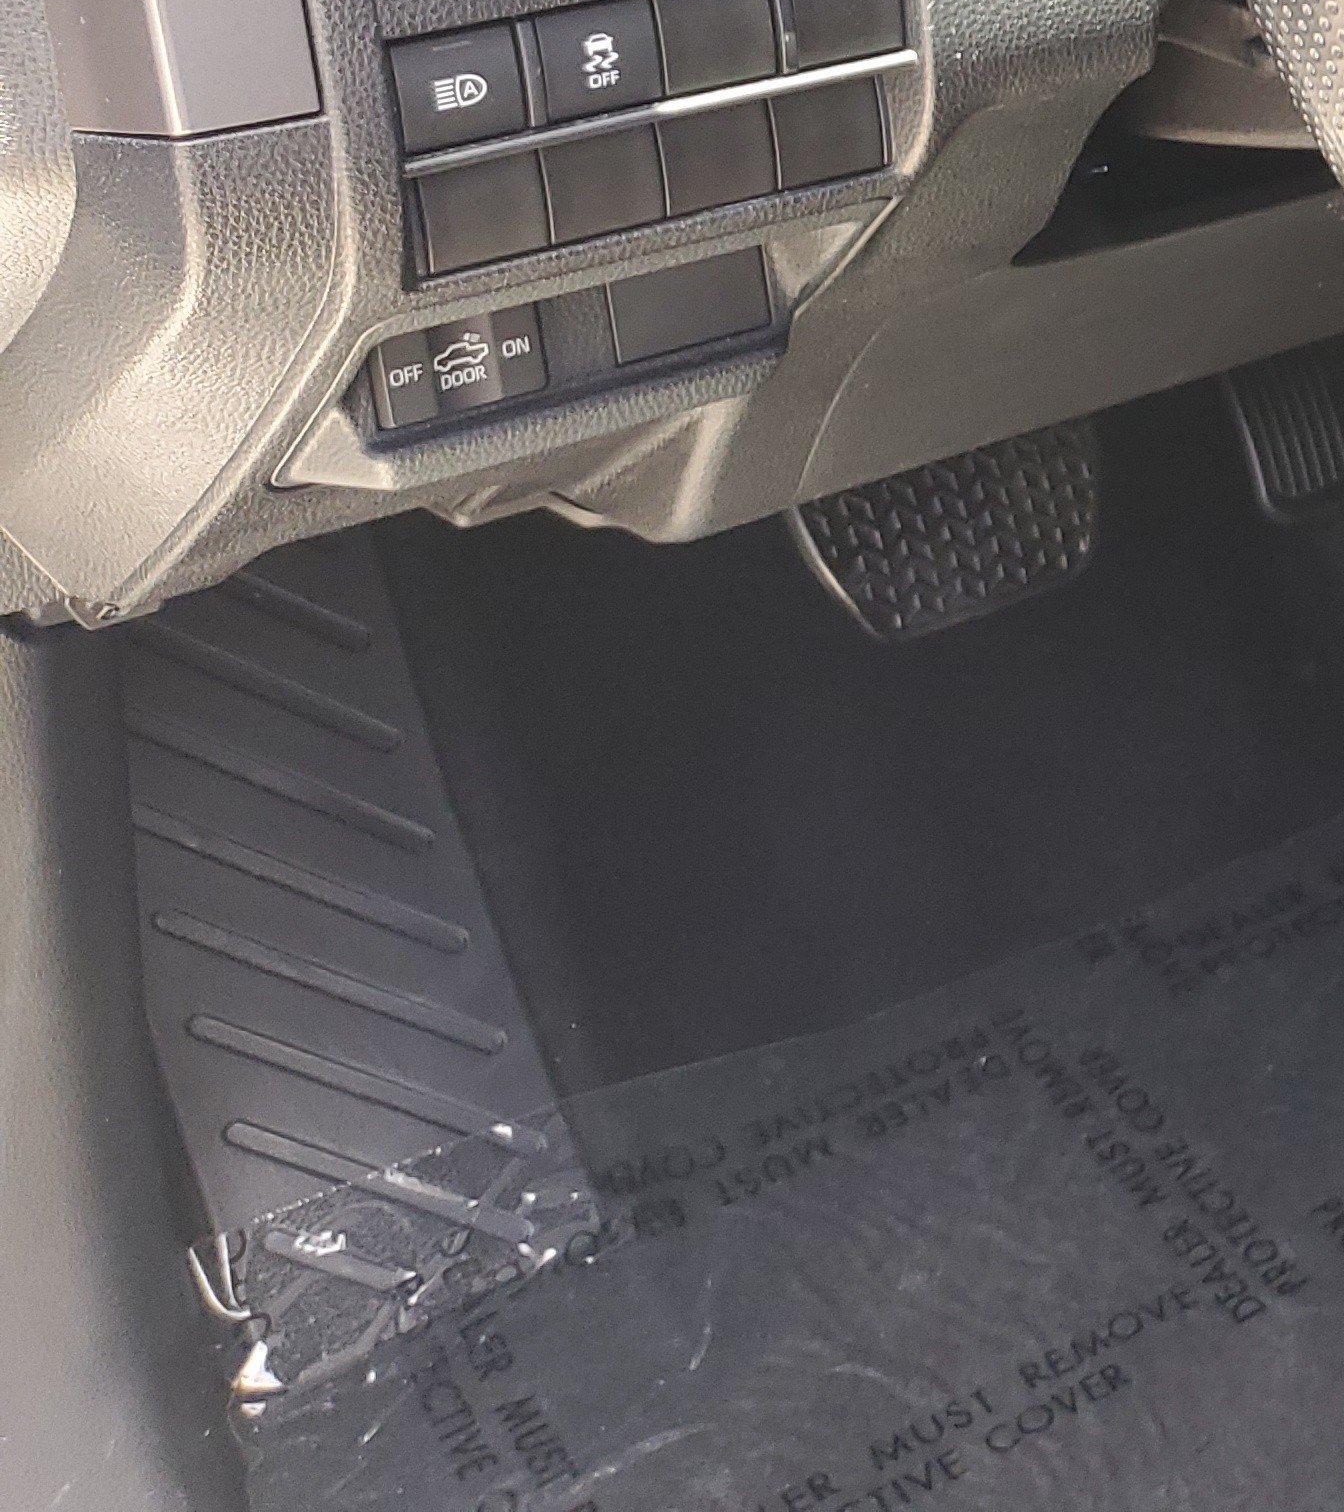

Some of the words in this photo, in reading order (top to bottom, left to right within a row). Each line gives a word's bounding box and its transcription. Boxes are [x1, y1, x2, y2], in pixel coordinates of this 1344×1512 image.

[589, 69, 621, 90] OFF
[389, 361, 423, 386] OFF
[440, 364, 487, 391] DOOR
[502, 335, 530, 357] ON
[858, 1054, 1011, 1139] DEALER
[992, 1008, 1096, 1119] REMOVE
[715, 1136, 834, 1207] MUST
[1086, 1129, 1168, 1209] MUST
[1154, 1135, 1308, 1295] PROTECTIVE
[1162, 1218, 1267, 1325] DEALER
[867, 1387, 994, 1472] MUST
[1017, 1285, 1199, 1389] REMOVE
[983, 1362, 1134, 1455] COVER
[494, 1392, 582, 1489] MUST
